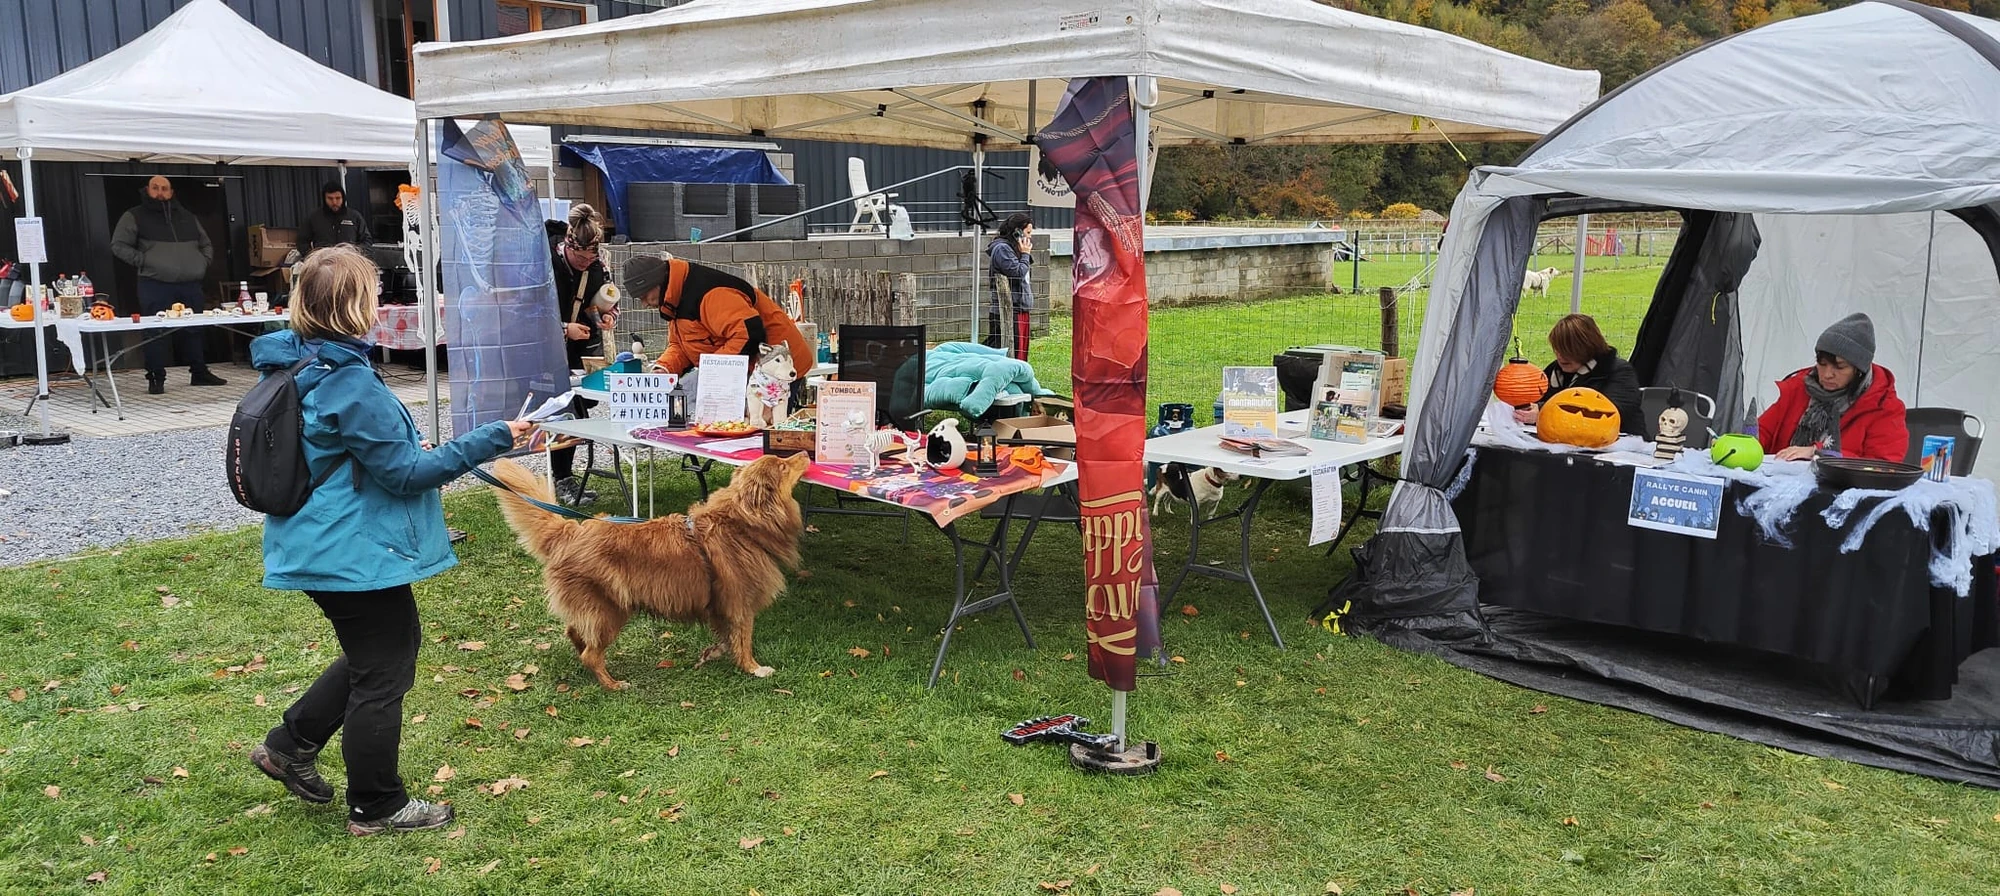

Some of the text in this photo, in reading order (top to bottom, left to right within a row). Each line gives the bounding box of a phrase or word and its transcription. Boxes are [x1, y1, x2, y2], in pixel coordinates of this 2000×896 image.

[703, 359, 744, 367] RESTAURATION
[627, 377, 660, 388] CYNO
[620, 408, 667, 420] #1YEAR
[1646, 481, 1708, 496] RALLYE CANIN
[1651, 495, 1698, 511] ACCUEIL
